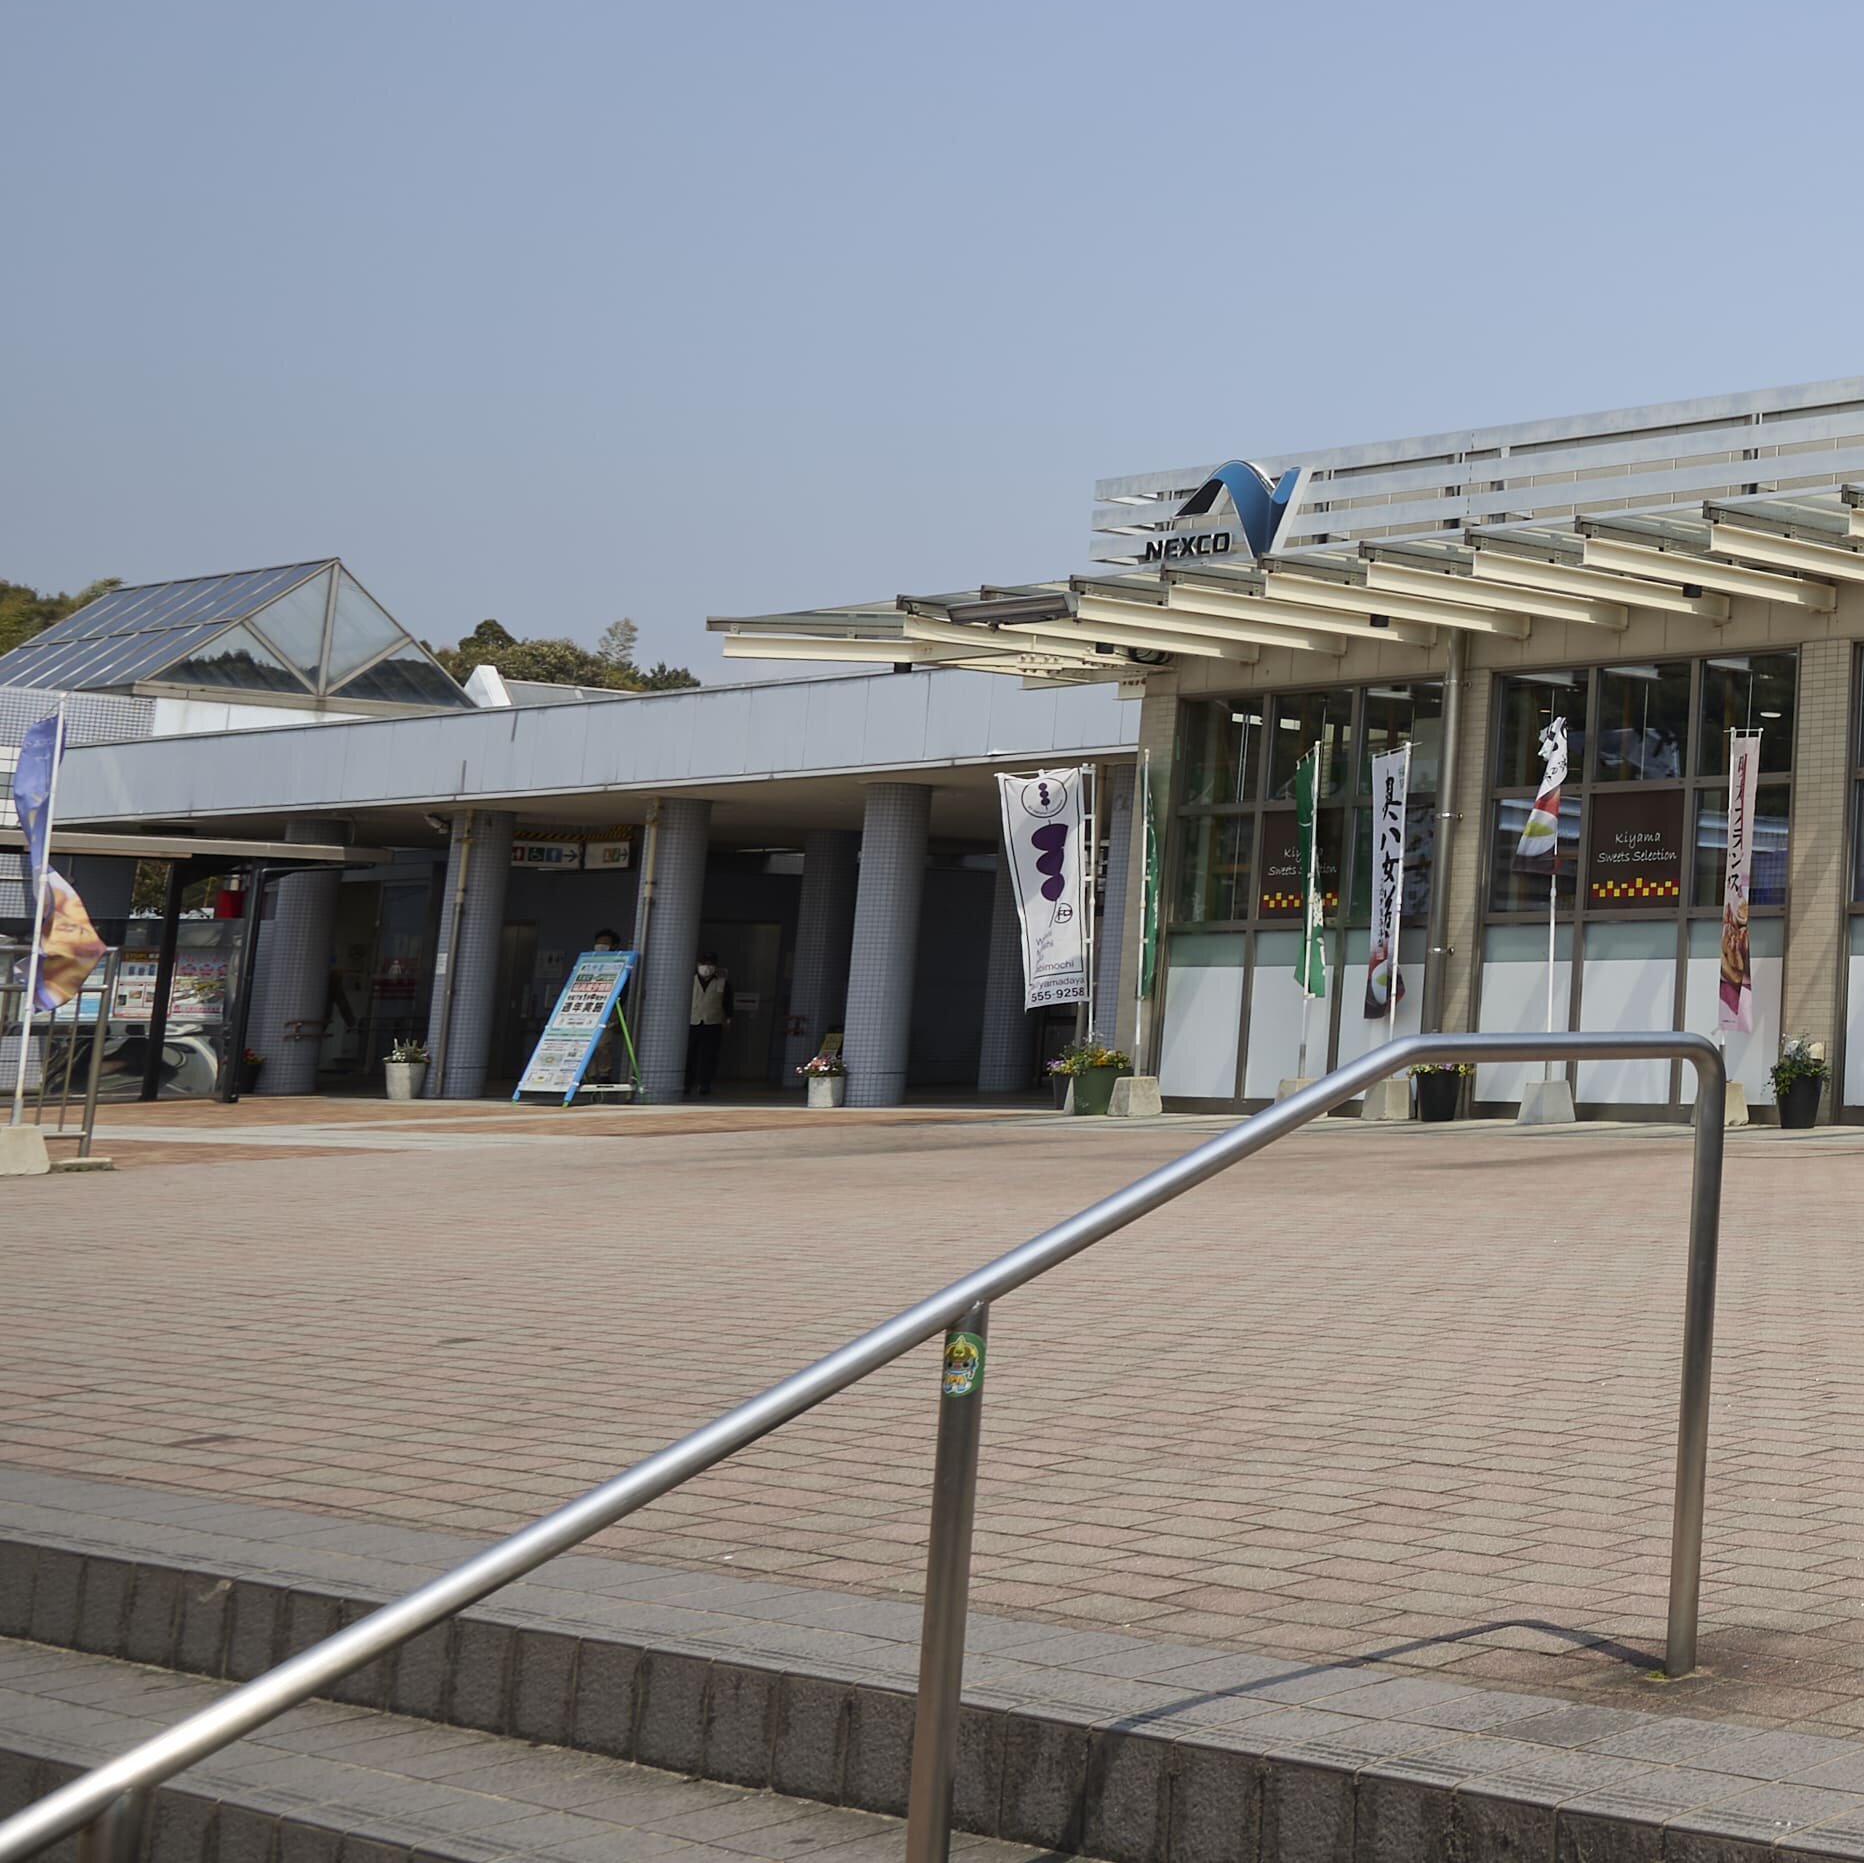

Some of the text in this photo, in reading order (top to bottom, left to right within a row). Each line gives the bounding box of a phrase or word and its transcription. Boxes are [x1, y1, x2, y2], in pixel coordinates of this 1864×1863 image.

[1146, 532, 1230, 560] NEXCO
[1615, 831, 1661, 849] Kiyama
[1597, 848, 1677, 863] Sweets Selection
